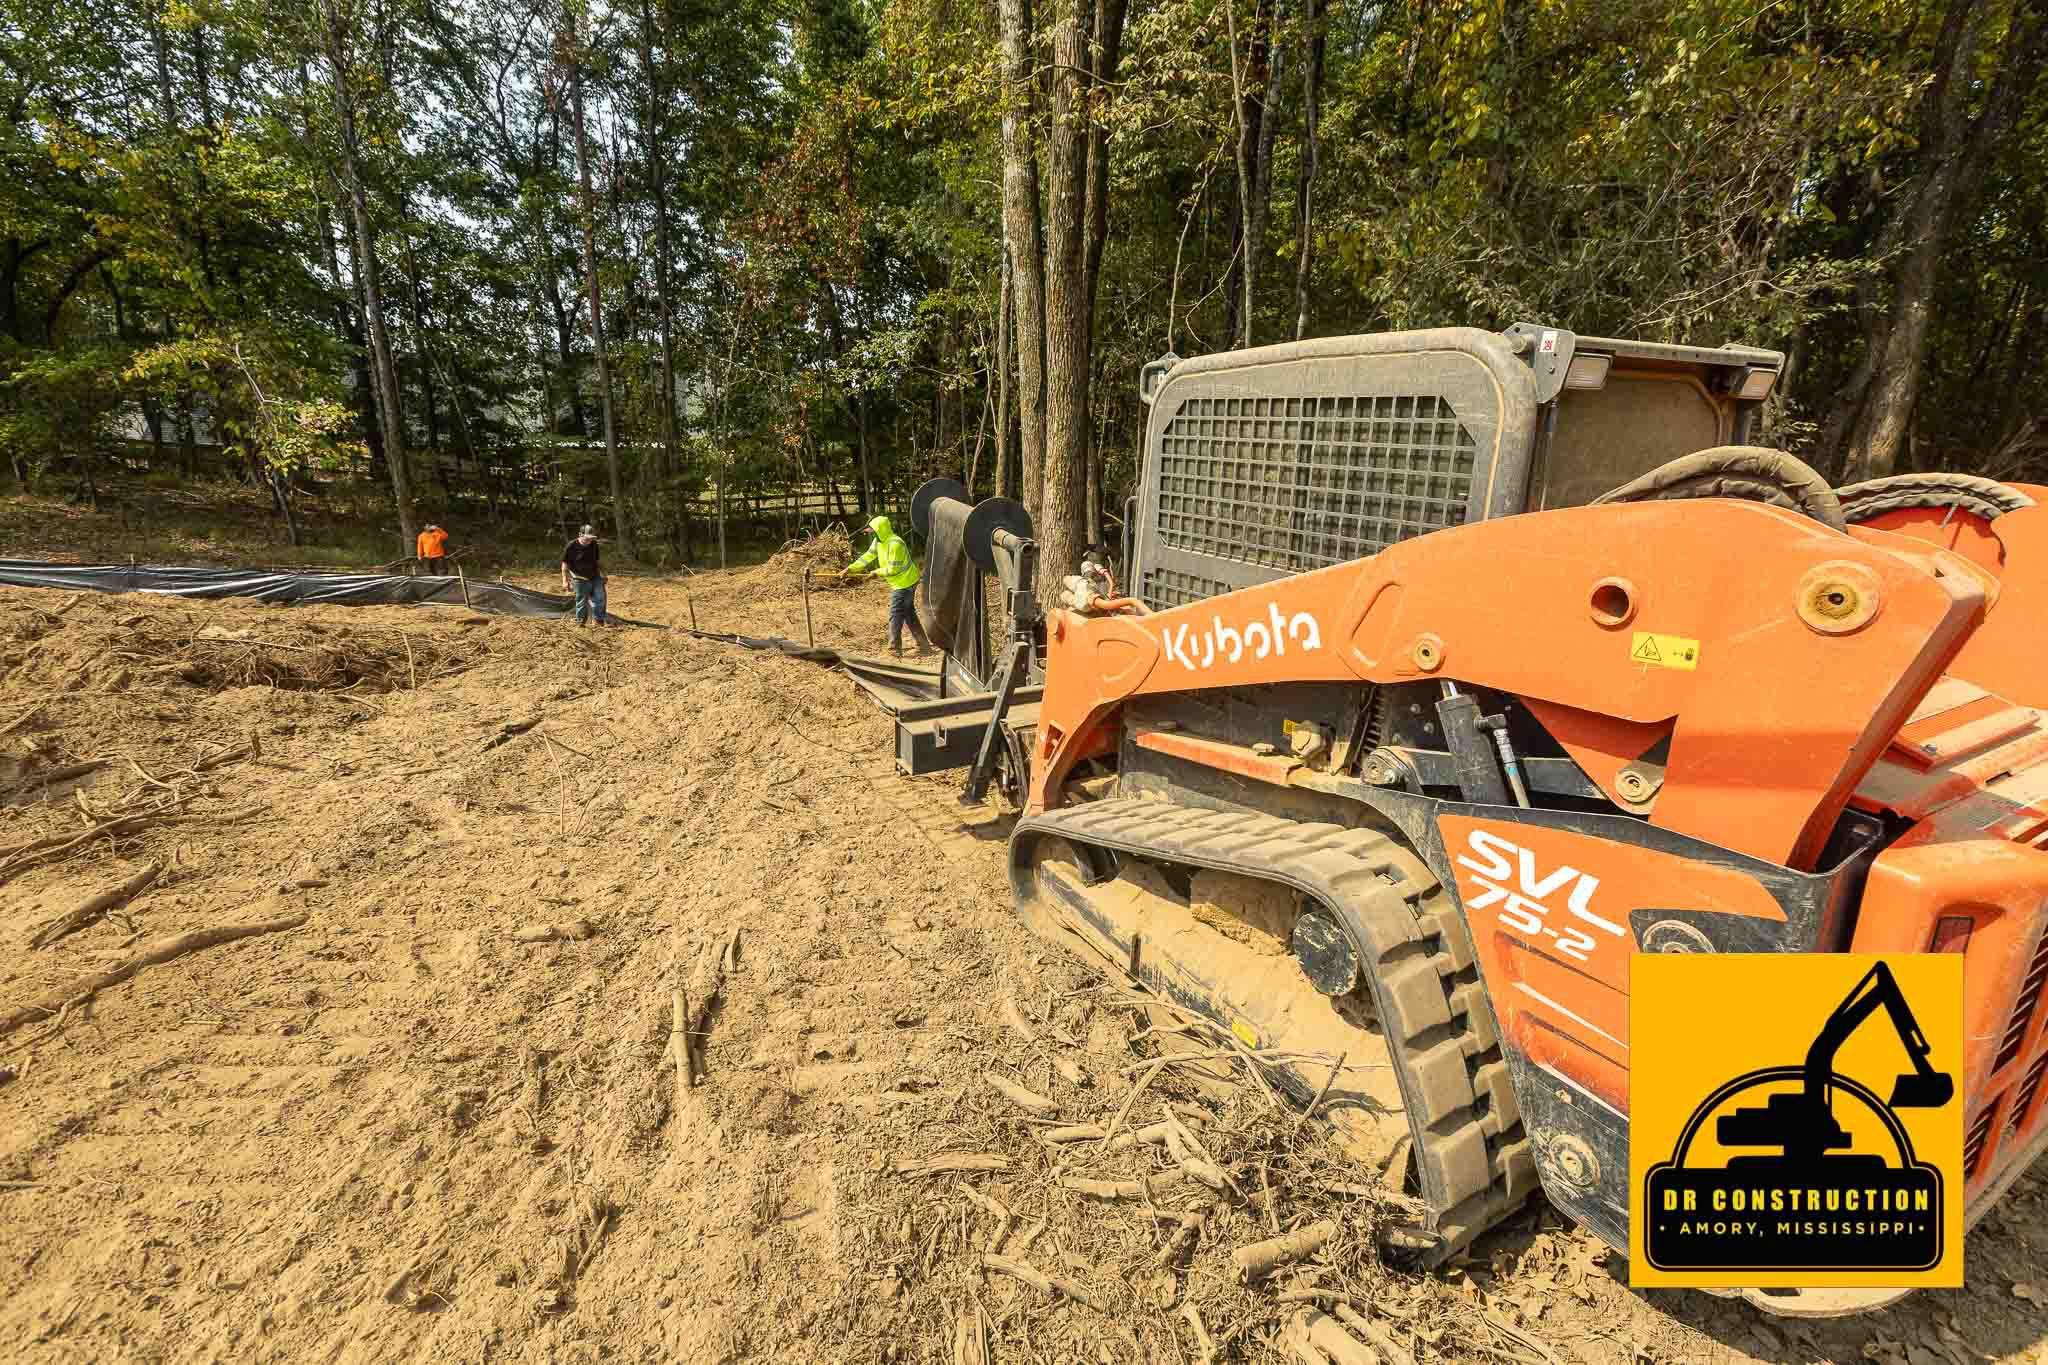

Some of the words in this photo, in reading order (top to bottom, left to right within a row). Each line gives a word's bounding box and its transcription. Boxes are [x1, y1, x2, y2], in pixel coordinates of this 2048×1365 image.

[1163, 601, 1322, 671] Kubota
[1456, 829, 1627, 937] SVL
[1465, 874, 1597, 961] 75-2
